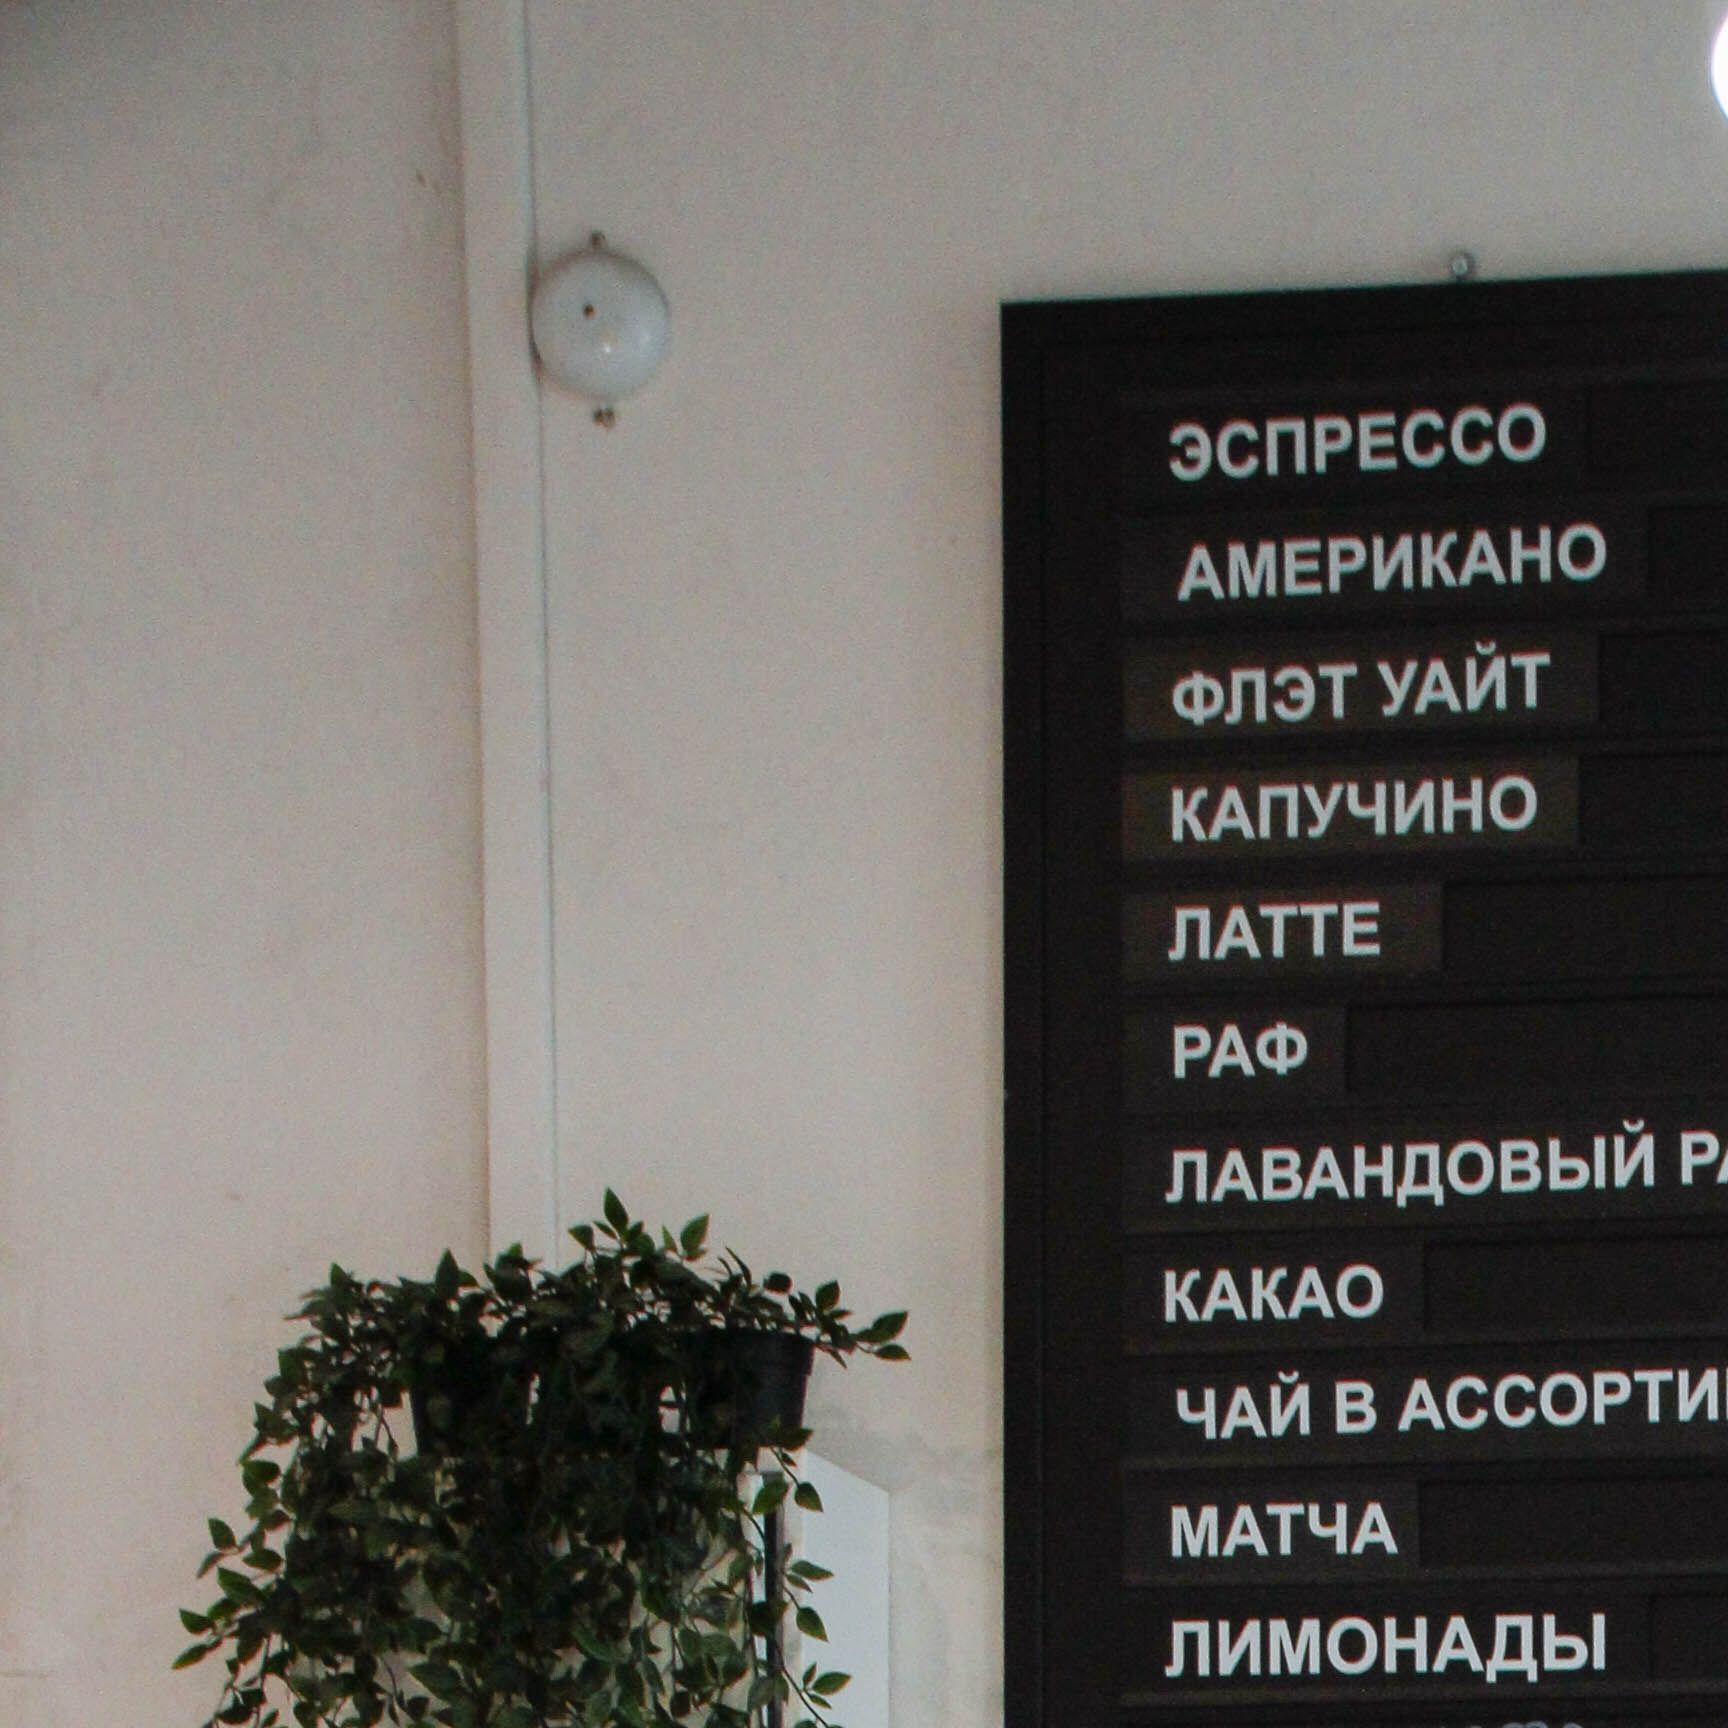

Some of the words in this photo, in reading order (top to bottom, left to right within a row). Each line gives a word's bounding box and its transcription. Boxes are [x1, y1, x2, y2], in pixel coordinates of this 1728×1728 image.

[1171, 406, 1545, 480] ЭСПРЕССО
[1179, 525, 1606, 600] АМЕРИКАНО
[1173, 664, 1357, 725] ФЛЭТ
[1378, 642, 1550, 716] УАЙТ
[1172, 776, 1537, 841] КАПУЧИНО
[1168, 902, 1380, 960] ЛАТТЕ
[1174, 1023, 1307, 1078] РАФ
[1166, 1120, 1654, 1207] ЛАВАНДОВЫЙ
[1165, 1265, 1383, 1322] КАКАО
[1177, 1371, 1310, 1439] ЧАЙ
[1336, 1382, 1377, 1433] В
[1172, 1503, 1398, 1557] МАТЧА
[1165, 1613, 1605, 1683] ЛИМОНАДЫ
